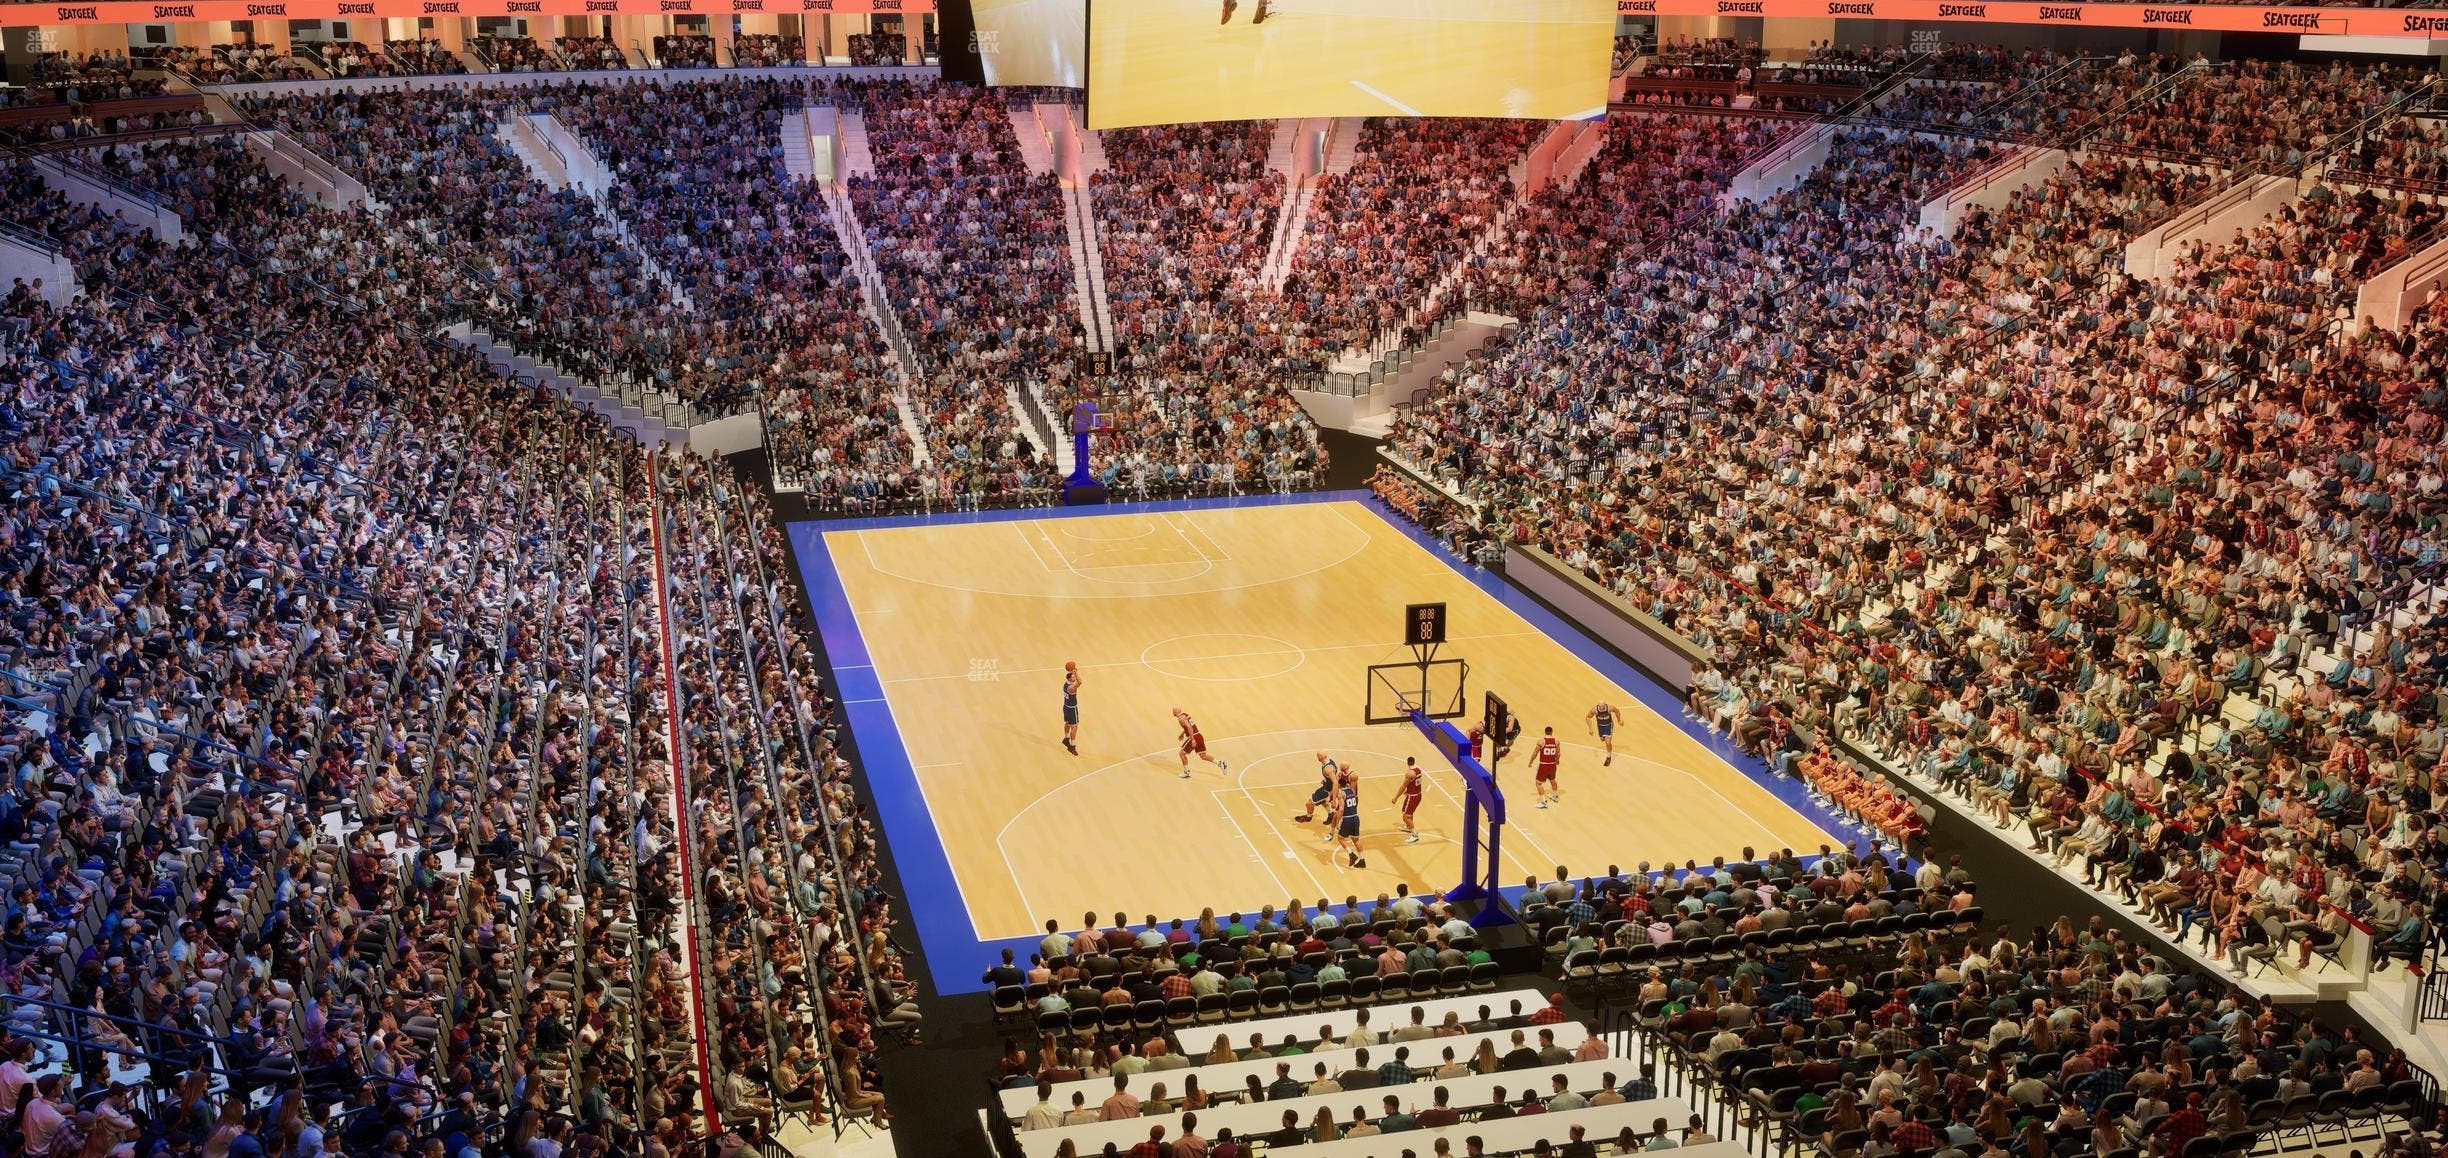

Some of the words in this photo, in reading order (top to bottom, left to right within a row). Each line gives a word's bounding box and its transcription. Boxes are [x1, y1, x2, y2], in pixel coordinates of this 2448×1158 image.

[154, 5, 195, 18] SEATGEEK
[247, 3, 287, 17] SEATGEEK
[338, 2, 376, 15] SEATGEEK
[424, 2, 459, 13] SEATGEEK
[507, 1, 541, 12] SEATGEEK
[586, 1, 618, 11] SEATGEEK
[661, 0, 692, 11] SEATGEEK
[733, 0, 763, 10] SEATGEEK
[804, 0, 833, 10] SEATGEEK
[873, 0, 902, 10] SEATGEEK
[1618, 0, 1656, 12] EATGEEK
[1717, 1, 1763, 13] SEATGEEK
[1828, 2, 1874, 16] SEATGEEK
[1938, 4, 1986, 18] SEATGEEK
[58, 7, 98, 21] SEATGEEK
[2039, 6, 2082, 21] SEATGEEK
[2143, 9, 2192, 25] SEATGEEK
[2263, 11, 2320, 29] SEATGEEK
[2403, 15, 2448, 32] SEATG
